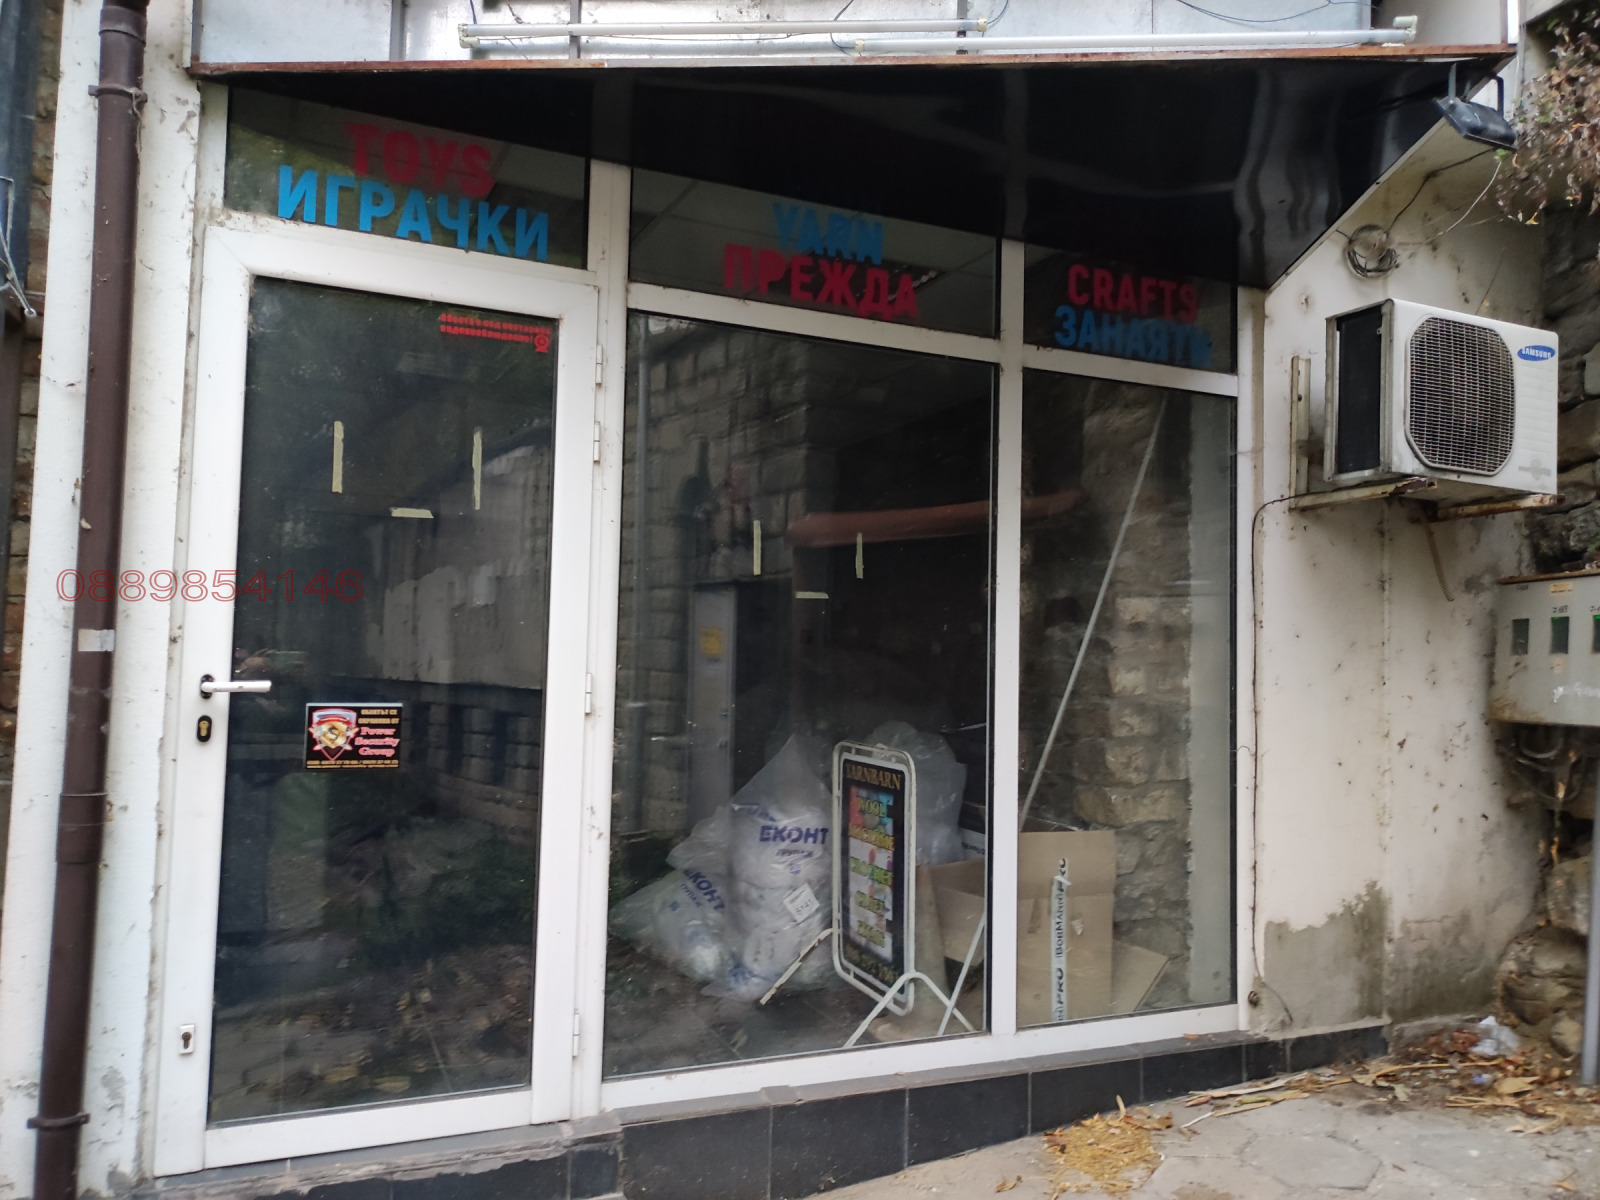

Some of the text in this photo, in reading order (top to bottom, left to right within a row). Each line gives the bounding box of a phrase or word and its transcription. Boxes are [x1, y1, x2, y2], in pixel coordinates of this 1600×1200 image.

[345, 121, 496, 198] TOYS
[277, 165, 549, 261] ИГРАЧКИ
[771, 201, 883, 265] YARN
[722, 243, 920, 324] ПРЕЖДА
[1067, 264, 1199, 325] CRAFTS
[1521, 347, 1552, 360] SAMSUNG
[759, 825, 829, 844] ЕКОНТ
